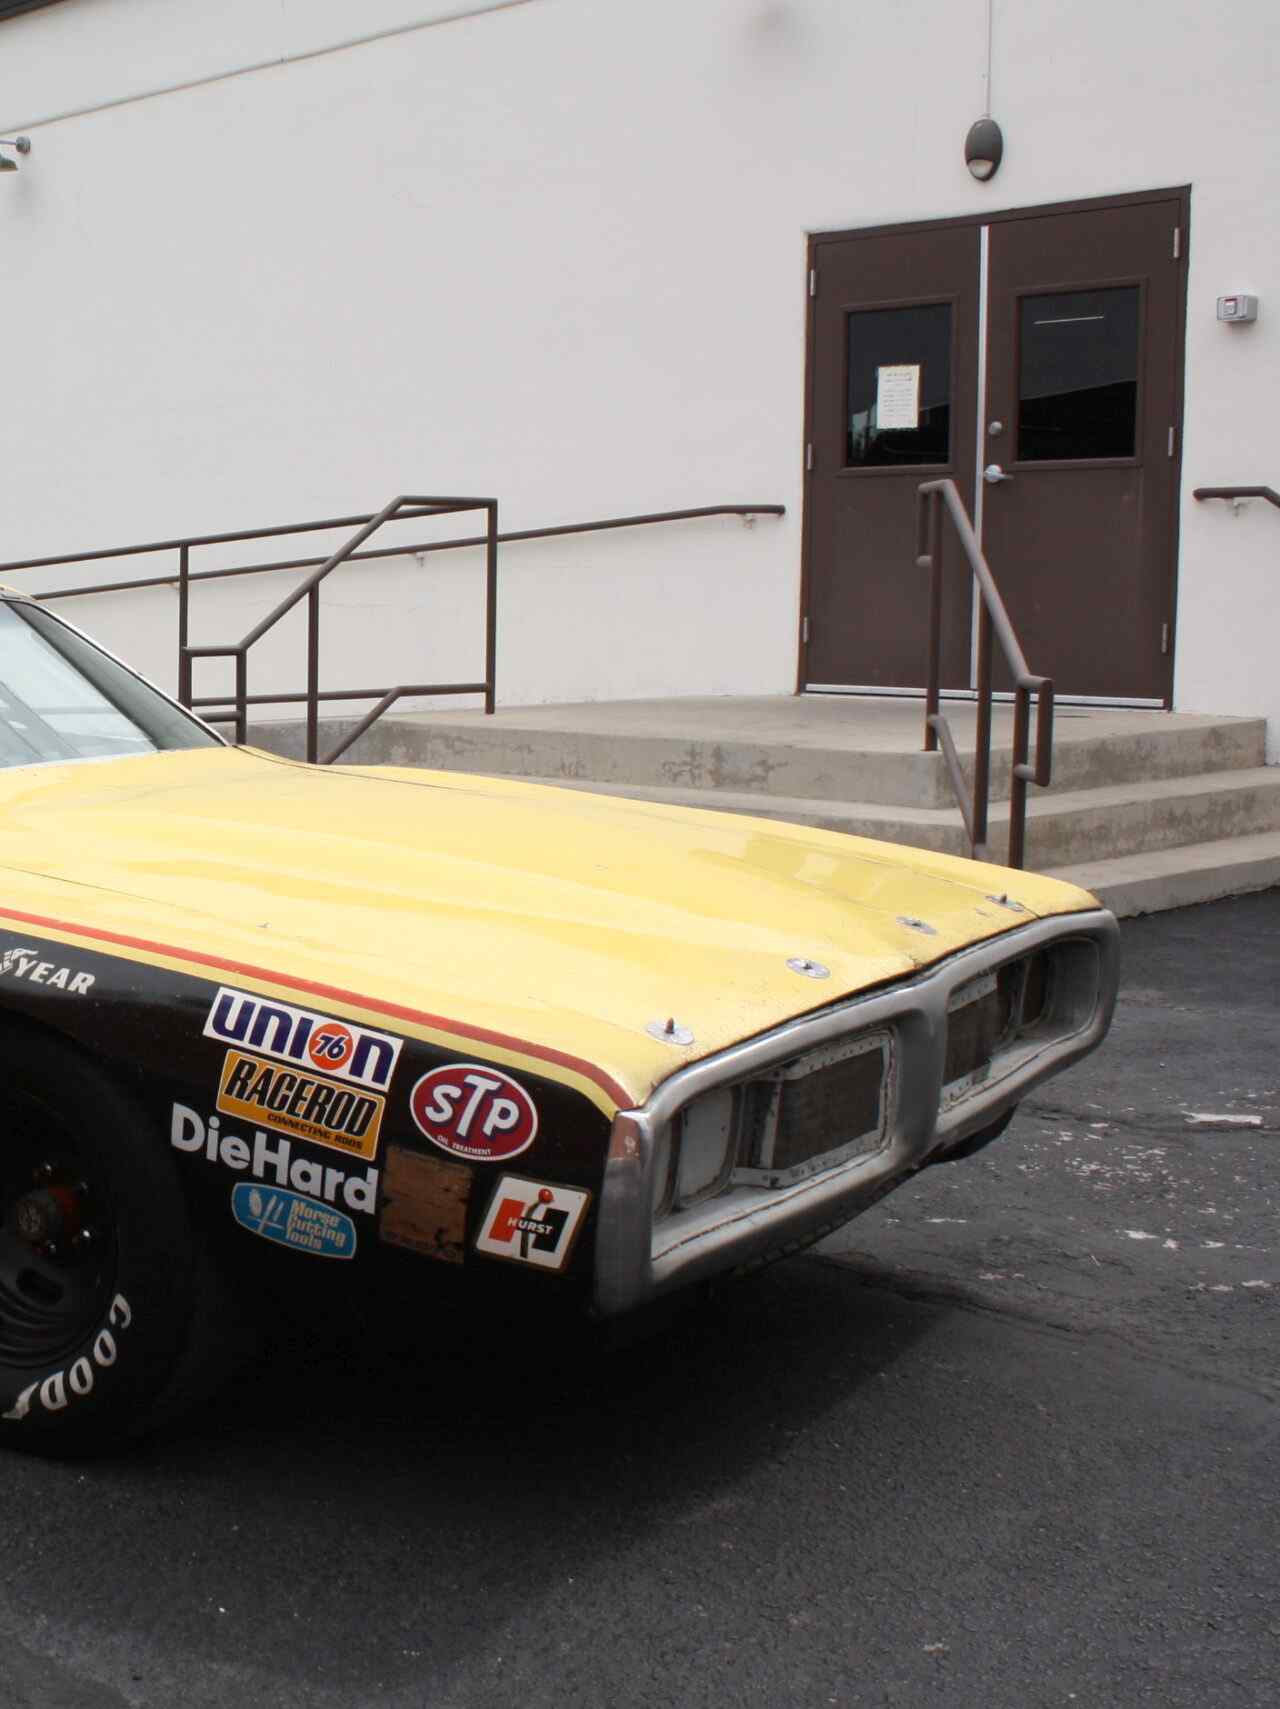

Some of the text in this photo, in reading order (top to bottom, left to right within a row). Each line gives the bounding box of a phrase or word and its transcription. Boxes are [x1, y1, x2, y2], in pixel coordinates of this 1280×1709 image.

[314, 1031, 345, 1060] 76
[224, 1056, 379, 1139] RACEROD
[424, 1073, 520, 1138] STP
[170, 1103, 379, 1215] DieHard
[507, 1217, 554, 1235] HURST
